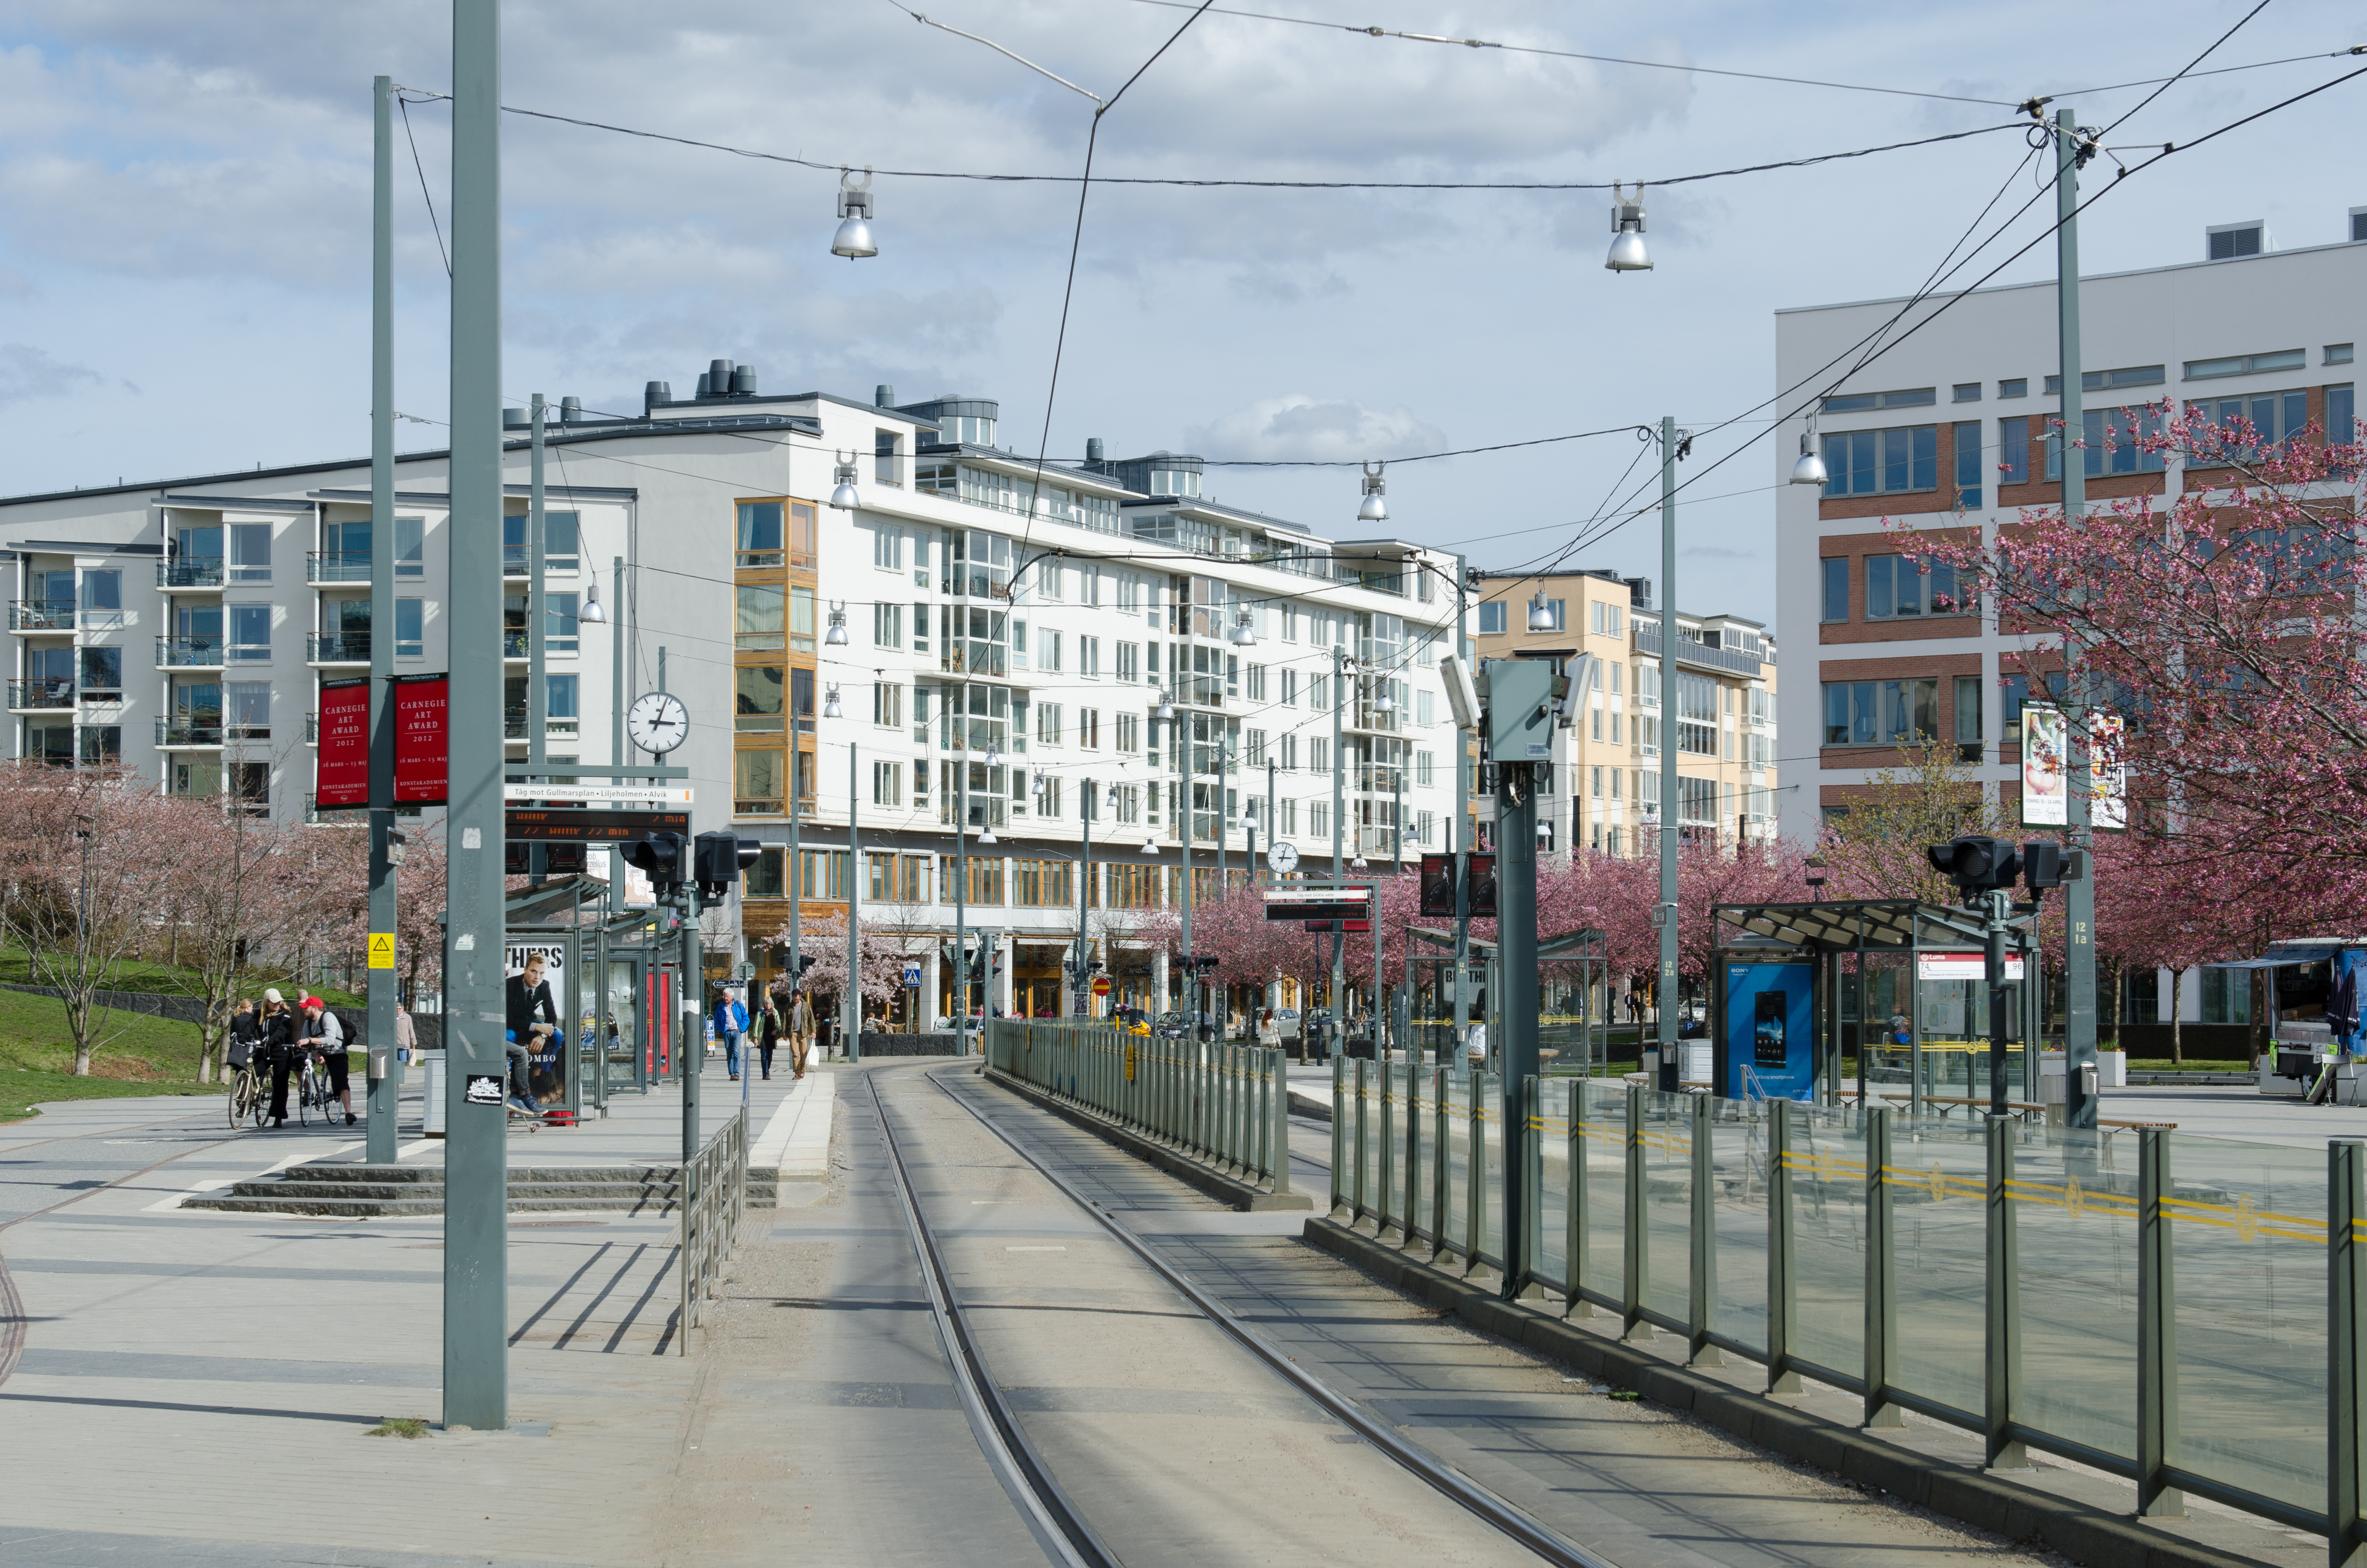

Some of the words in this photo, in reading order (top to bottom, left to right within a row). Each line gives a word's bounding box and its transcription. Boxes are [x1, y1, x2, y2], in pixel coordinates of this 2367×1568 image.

[401, 700, 445, 709] CARNEGIE
[325, 704, 365, 715] CARNEGIE
[332, 726, 359, 734] AWARD
[408, 721, 438, 730] AWARD
[515, 788, 527, 796] Tåg
[547, 789, 594, 797] Gullmarsplan
[601, 790, 643, 798] Liljeholmen
[2076, 922, 2086, 932] 12
[2075, 934, 2087, 944] 1a
[708, 1021, 713, 1030] P
